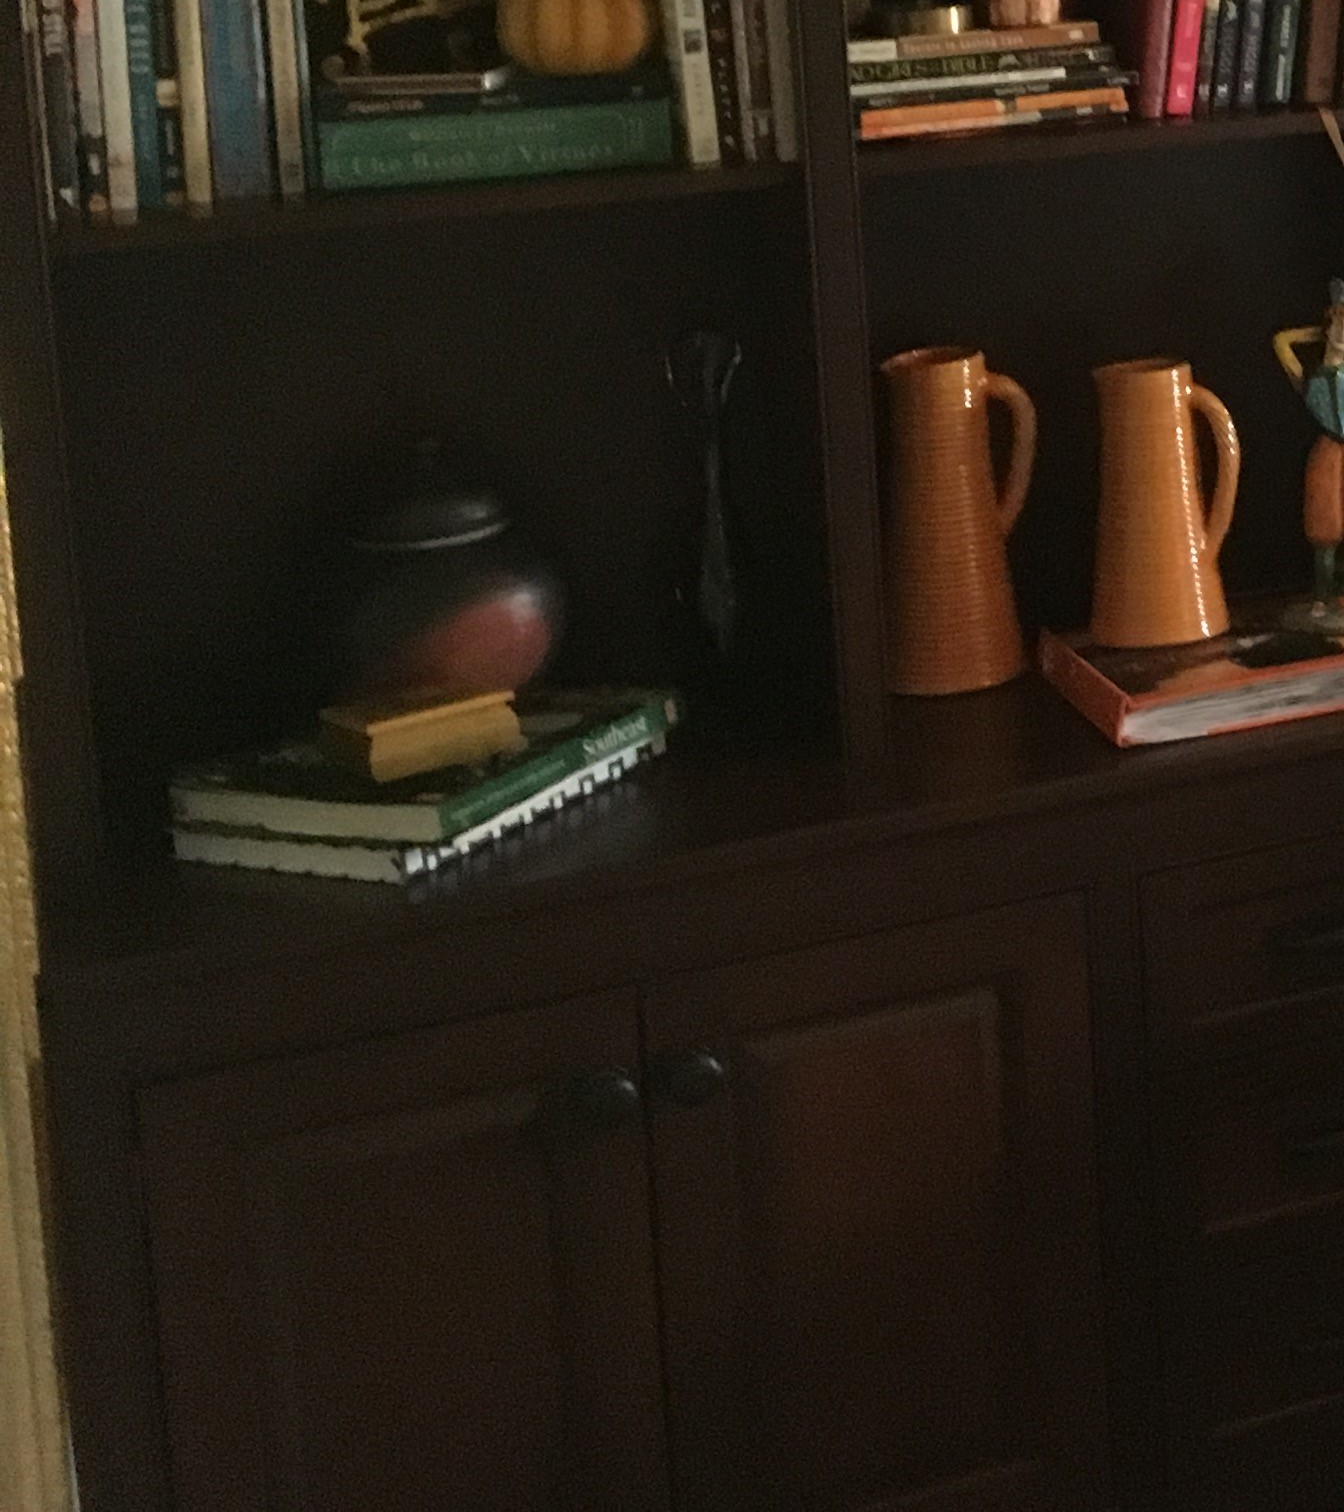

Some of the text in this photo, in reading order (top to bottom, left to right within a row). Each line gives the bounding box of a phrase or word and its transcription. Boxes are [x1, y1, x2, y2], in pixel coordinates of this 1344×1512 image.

[941, 55, 995, 73] BIBLE
[716, 57, 733, 121] PLATT
[581, 714, 648, 756] Southeast
